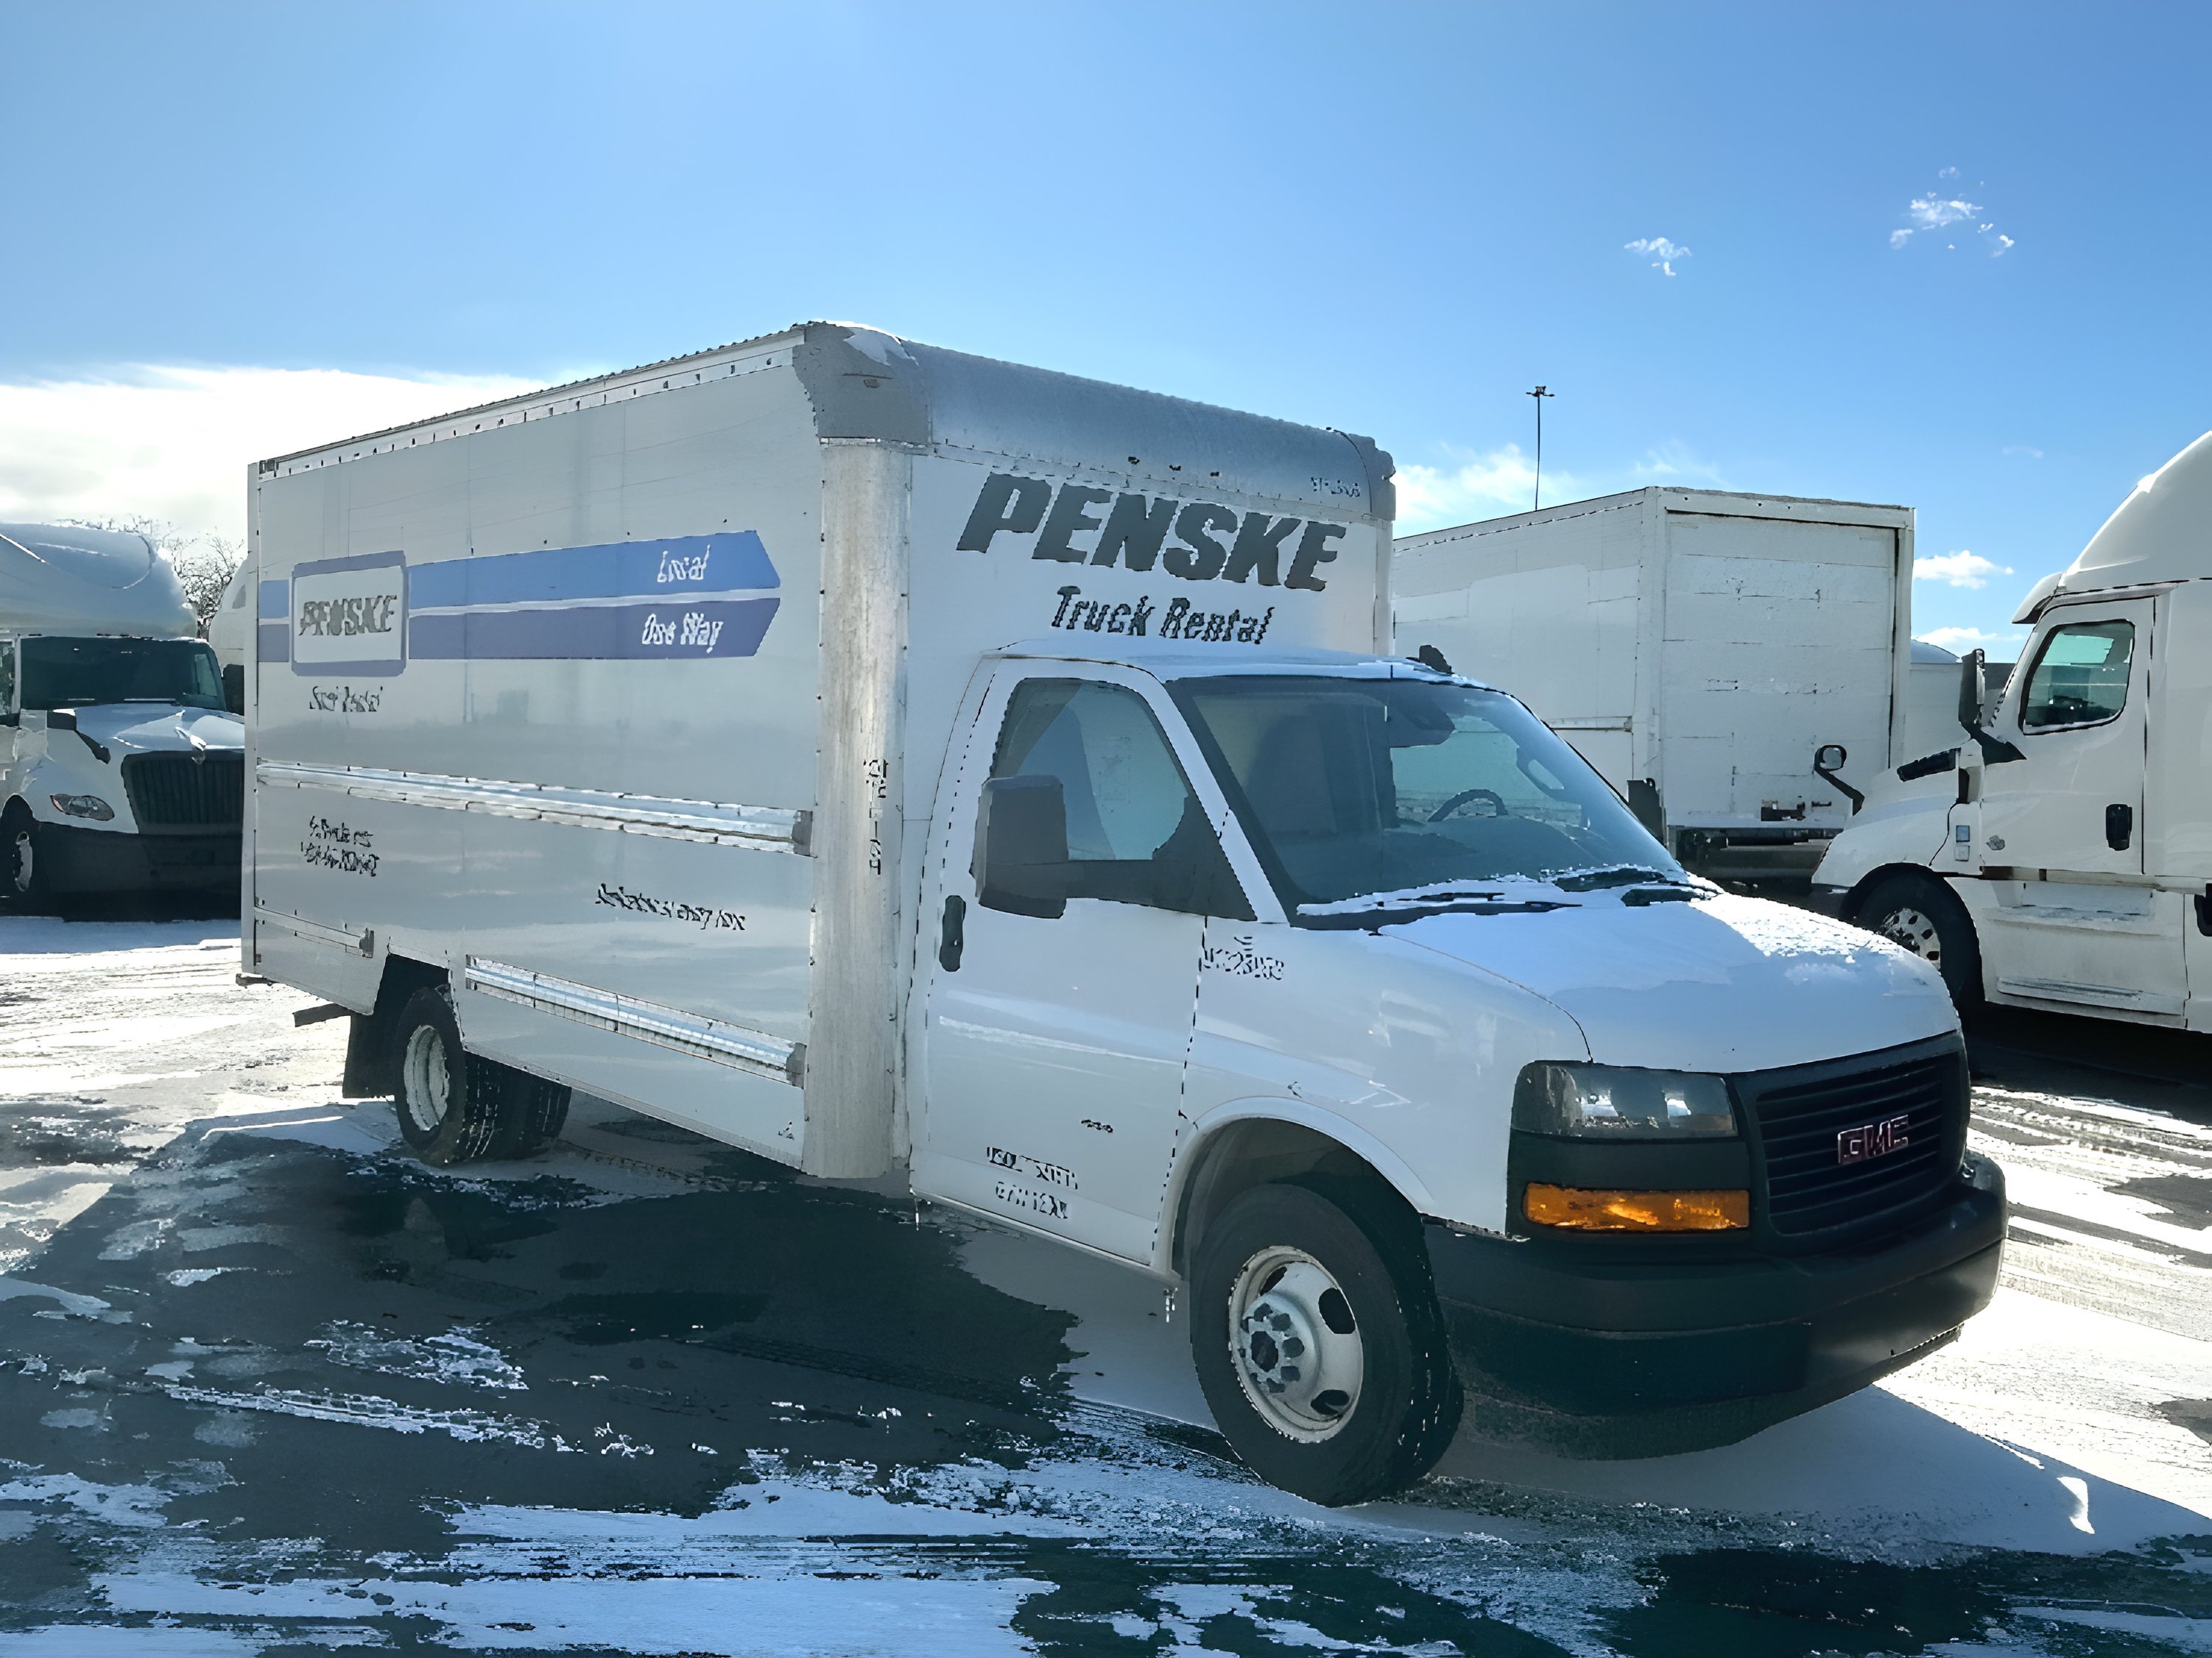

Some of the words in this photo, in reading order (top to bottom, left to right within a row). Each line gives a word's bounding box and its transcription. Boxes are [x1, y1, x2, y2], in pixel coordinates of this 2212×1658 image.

[957, 472, 1347, 592] PENSKE
[1052, 585, 1155, 636] Truck
[1160, 598, 1275, 645] Rental
